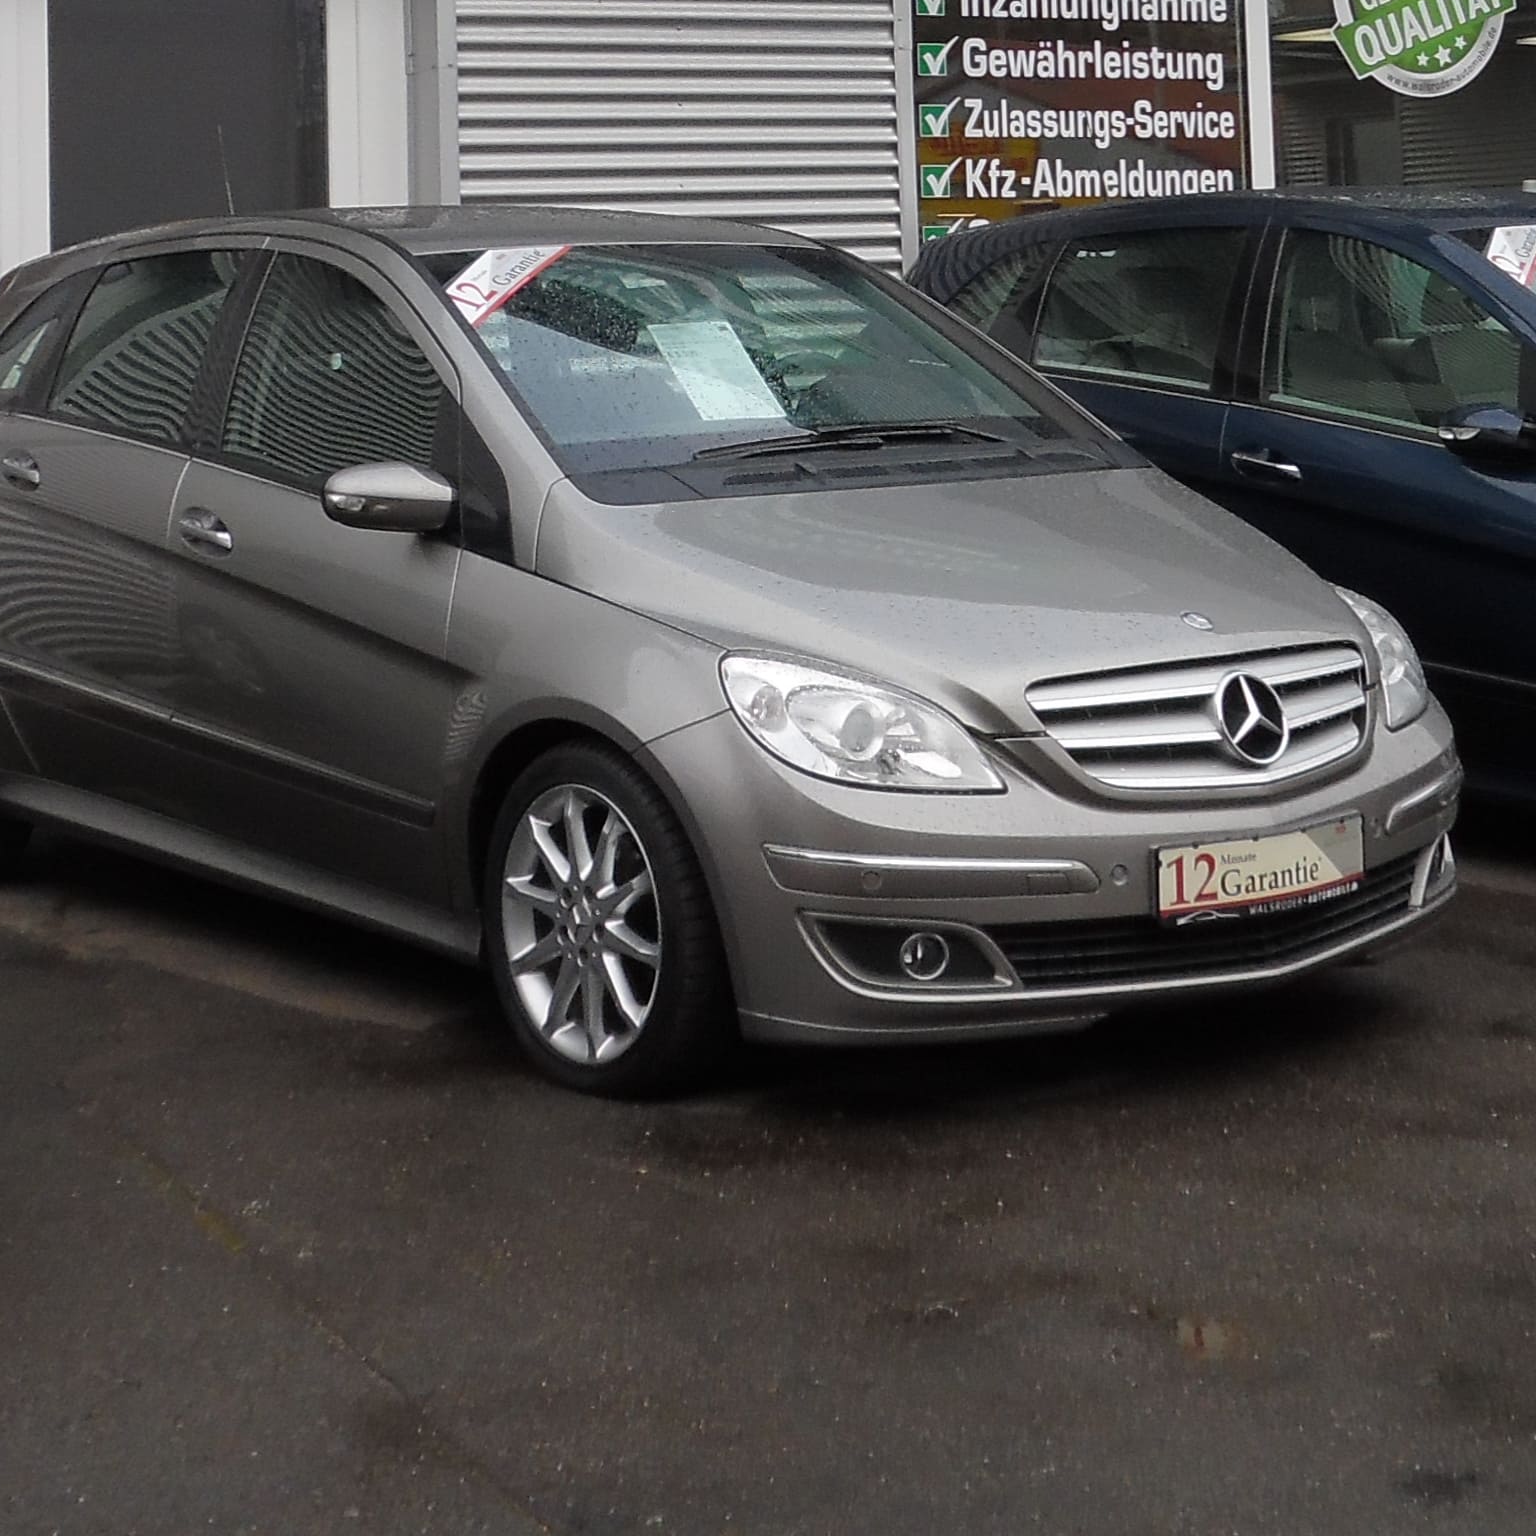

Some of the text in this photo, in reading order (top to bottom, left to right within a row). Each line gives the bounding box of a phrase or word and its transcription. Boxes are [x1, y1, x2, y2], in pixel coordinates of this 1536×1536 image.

[962, 37, 1224, 91] Gewährleistung
[964, 98, 1236, 149] Zulassungs-Service
[492, 248, 546, 286] Garantie
[447, 282, 499, 311] 12
[1166, 852, 1321, 907] 12 Garantie
